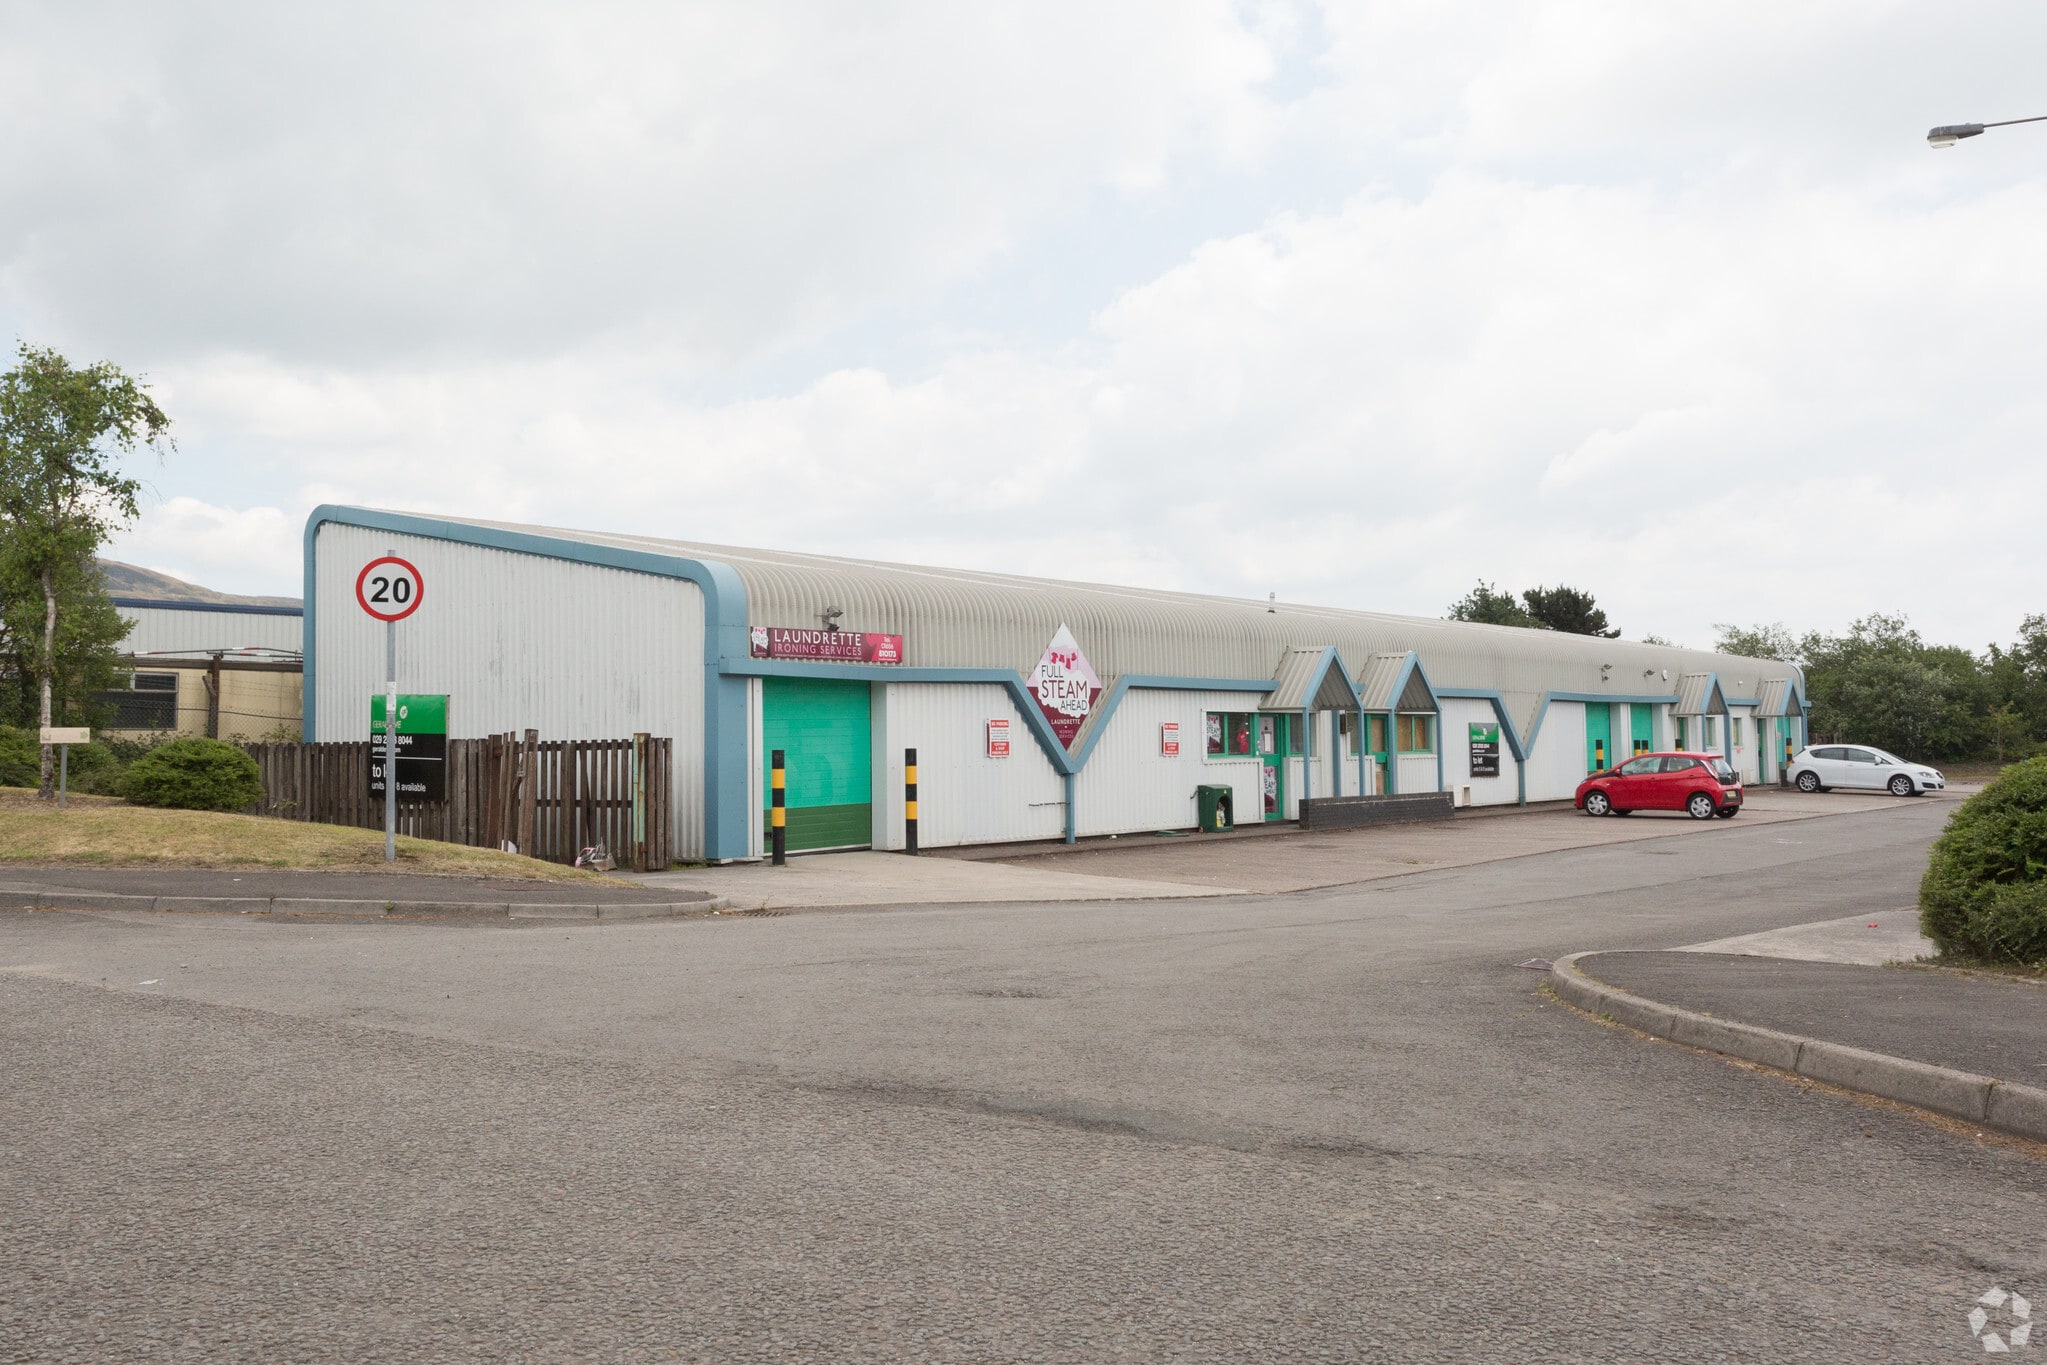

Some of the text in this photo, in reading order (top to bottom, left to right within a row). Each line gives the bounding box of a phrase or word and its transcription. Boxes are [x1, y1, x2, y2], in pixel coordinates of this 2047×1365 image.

[371, 577, 410, 603] 20
[774, 629, 861, 646] LAUNDRETTE
[774, 643, 862, 656] IRONING SERVICES
[1041, 665, 1064, 678] FULL
[1041, 680, 1088, 699] STEAM
[1060, 700, 1088, 711] AHEAD
[398, 736, 413, 745] 8044
[372, 764, 382, 778] to
[372, 782, 384, 790] units
[401, 782, 426, 792] available
